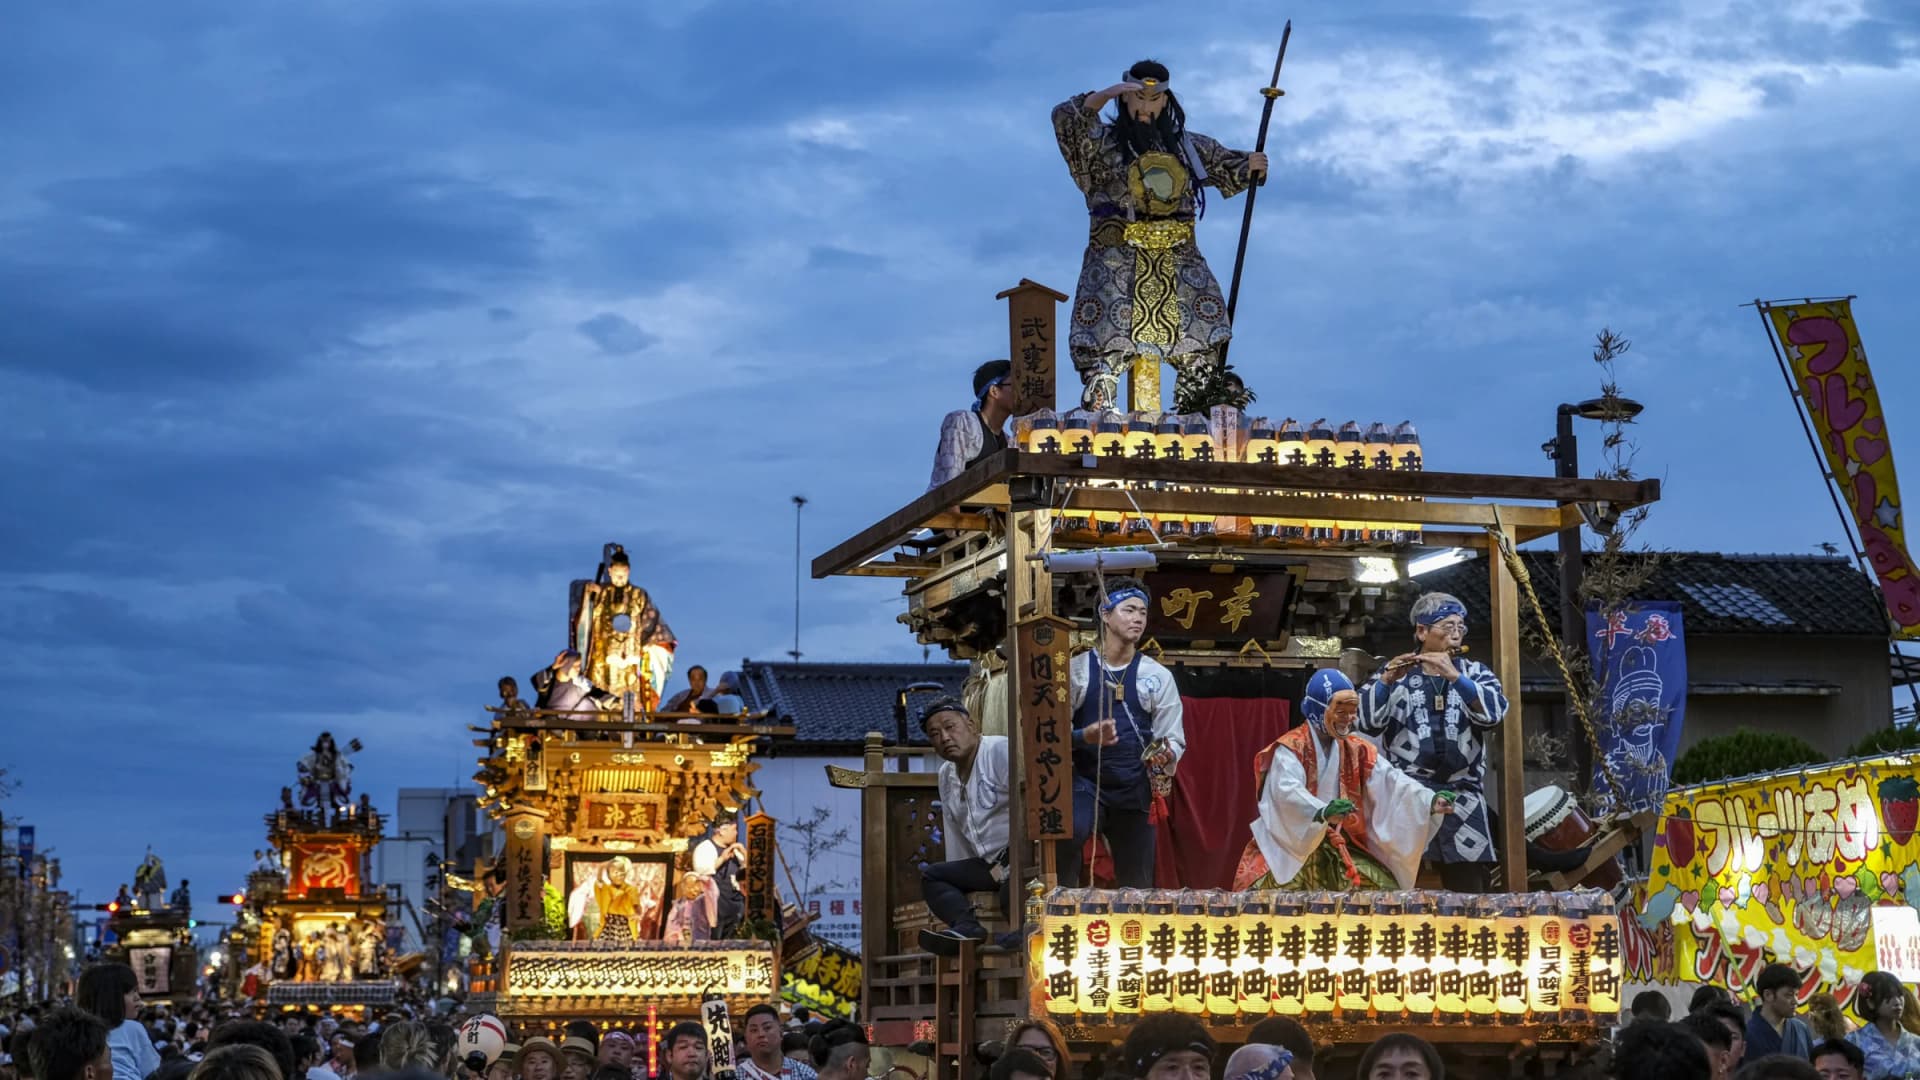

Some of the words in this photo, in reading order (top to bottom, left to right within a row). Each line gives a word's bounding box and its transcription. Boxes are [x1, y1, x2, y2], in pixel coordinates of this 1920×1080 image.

[1020, 316, 1053, 412] 武甕槌
[1160, 575, 1260, 633] 幸町
[1694, 775, 1879, 877] フルーツあめ
[1049, 923, 1078, 1003] 幸町
[1146, 922, 1175, 1003] 幸町
[1177, 923, 1207, 1003] 幸町
[1208, 924, 1239, 1003] 幸町
[1243, 921, 1272, 1001] 幸町
[1276, 924, 1305, 1004] 幸町
[1307, 921, 1338, 1001] 幸町
[1342, 923, 1371, 1001] 幸町
[1375, 922, 1405, 1001] 幸町
[1408, 921, 1438, 1001] 幸町
[1438, 923, 1468, 1001] 幸町
[1468, 925, 1498, 1001] 幸町
[1500, 924, 1530, 1003] 幸町
[1591, 923, 1619, 1006] 幸町
